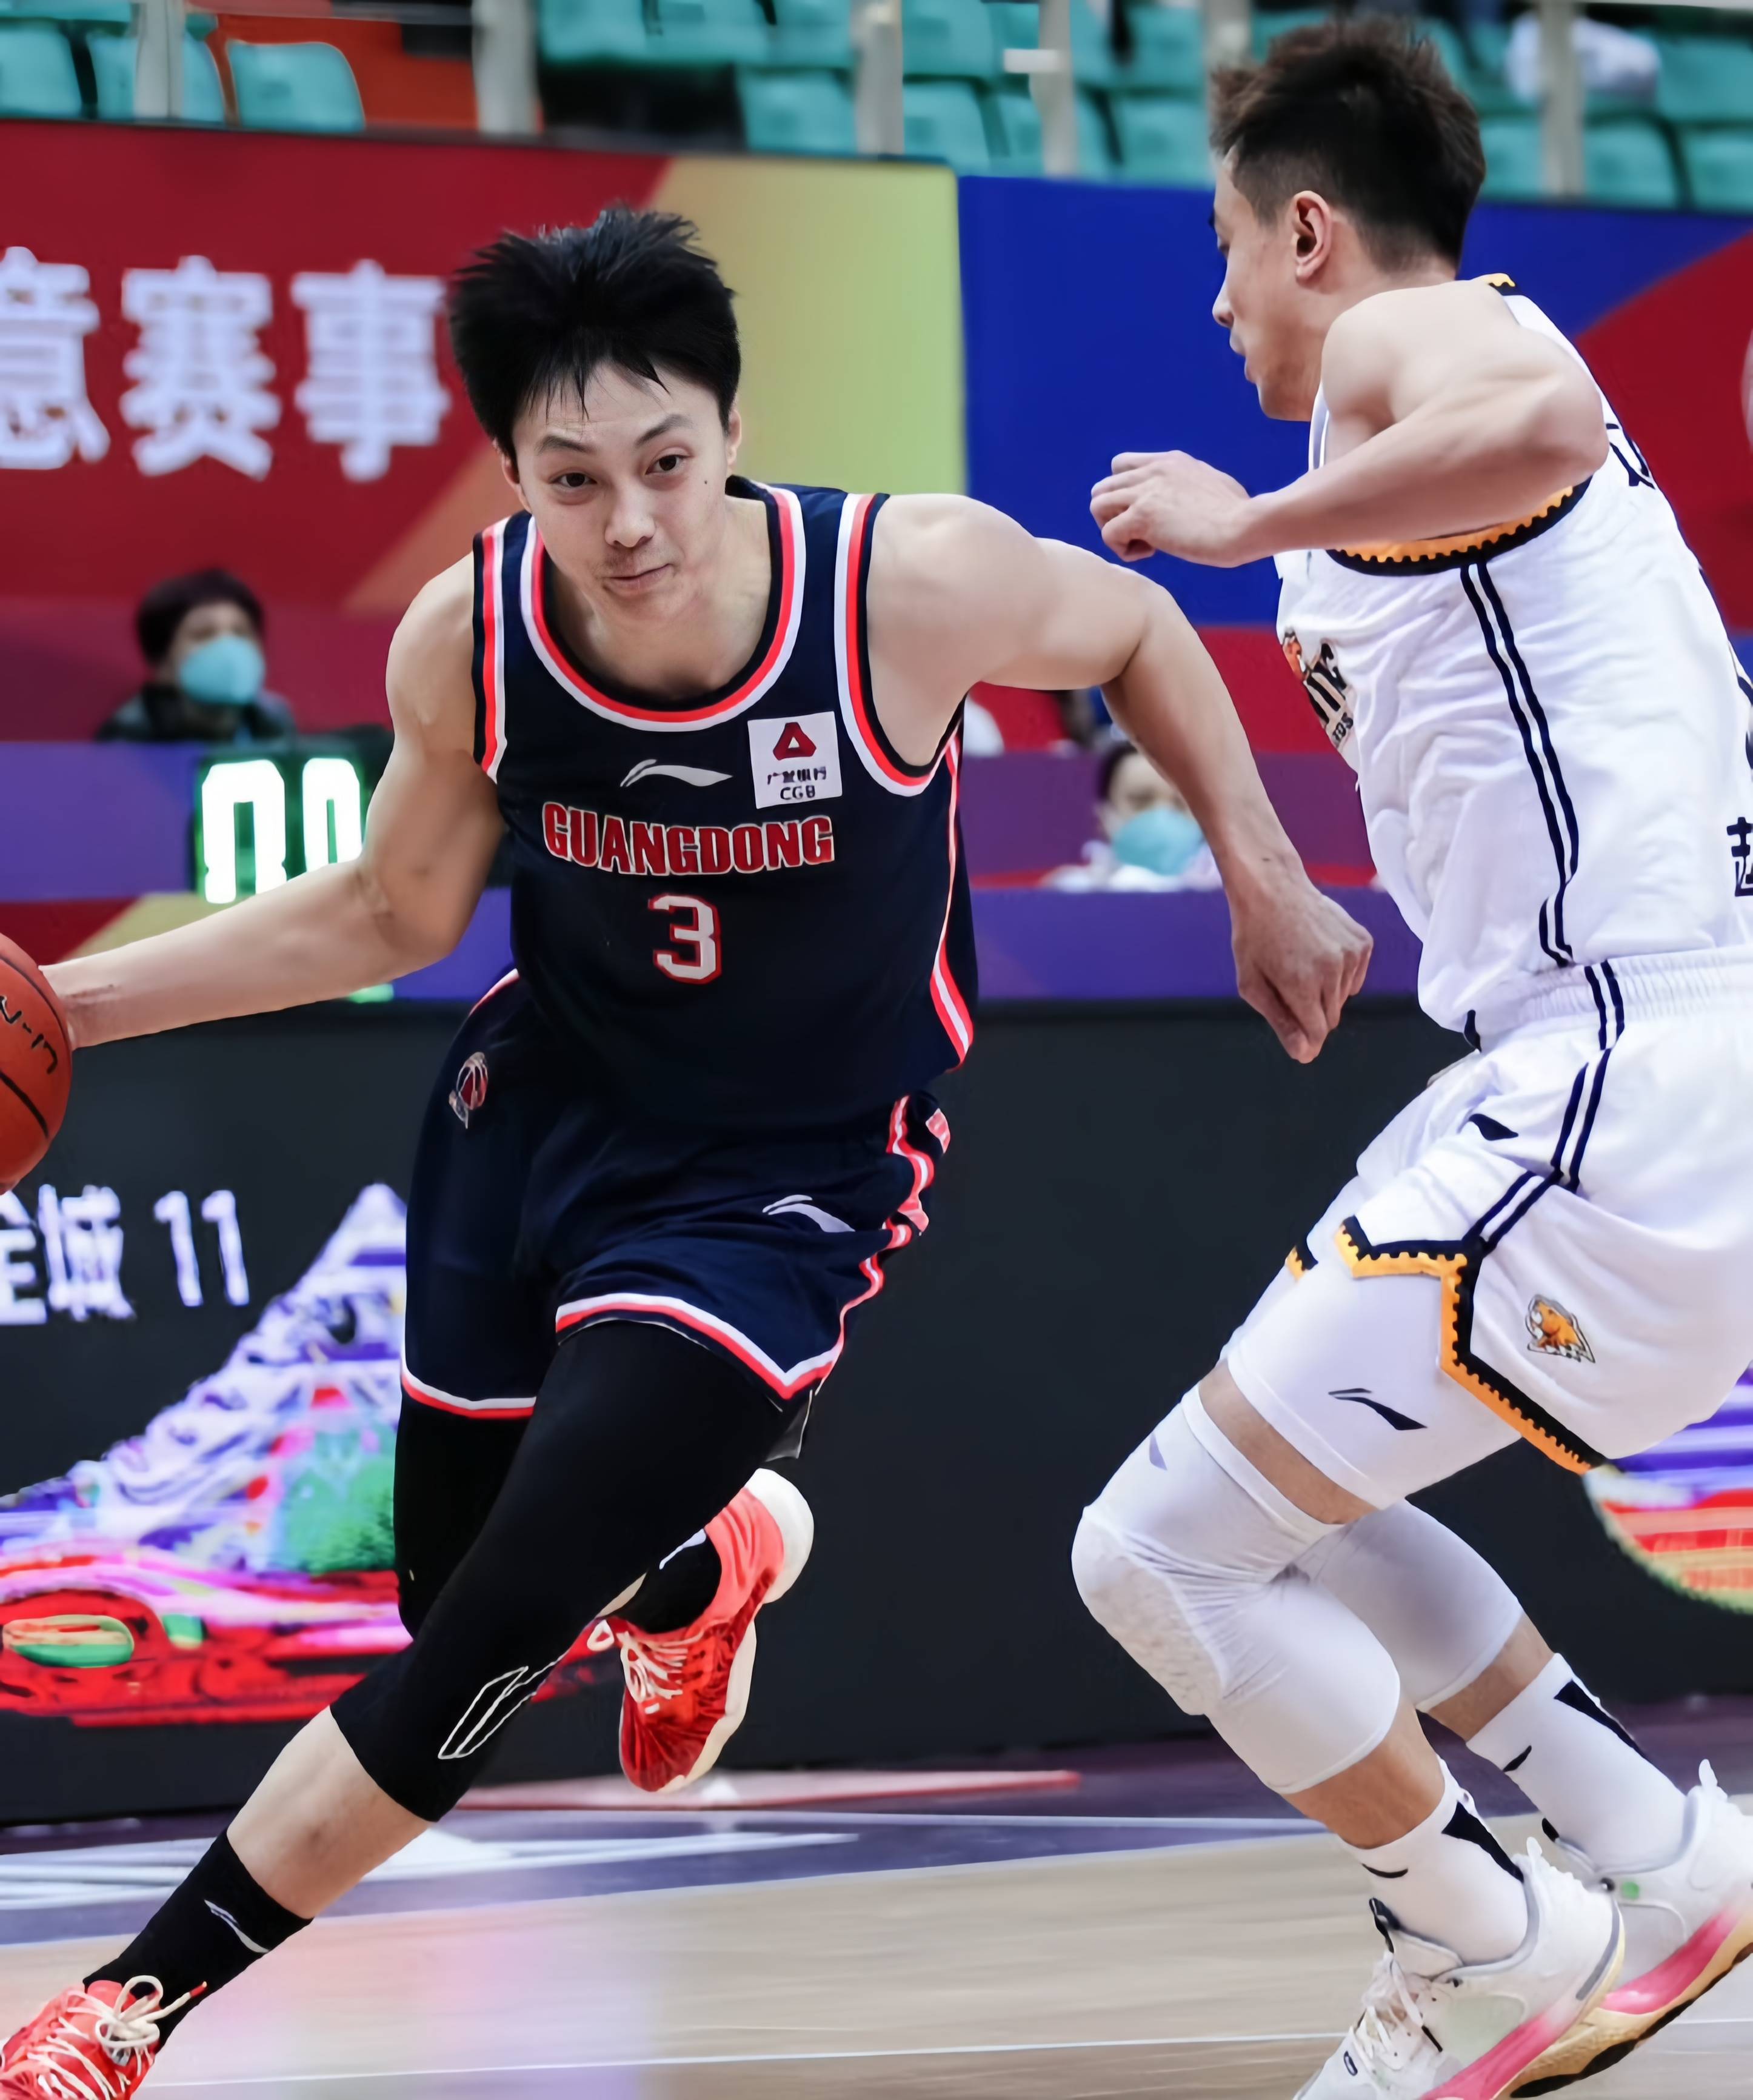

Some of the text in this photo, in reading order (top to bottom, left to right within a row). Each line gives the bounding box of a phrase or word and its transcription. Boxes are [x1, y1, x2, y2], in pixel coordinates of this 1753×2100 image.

[780, 785, 815, 800] CGB
[542, 801, 835, 876] GUANGDONG
[647, 892, 723, 985] 3
[154, 1189, 250, 1308] 11
